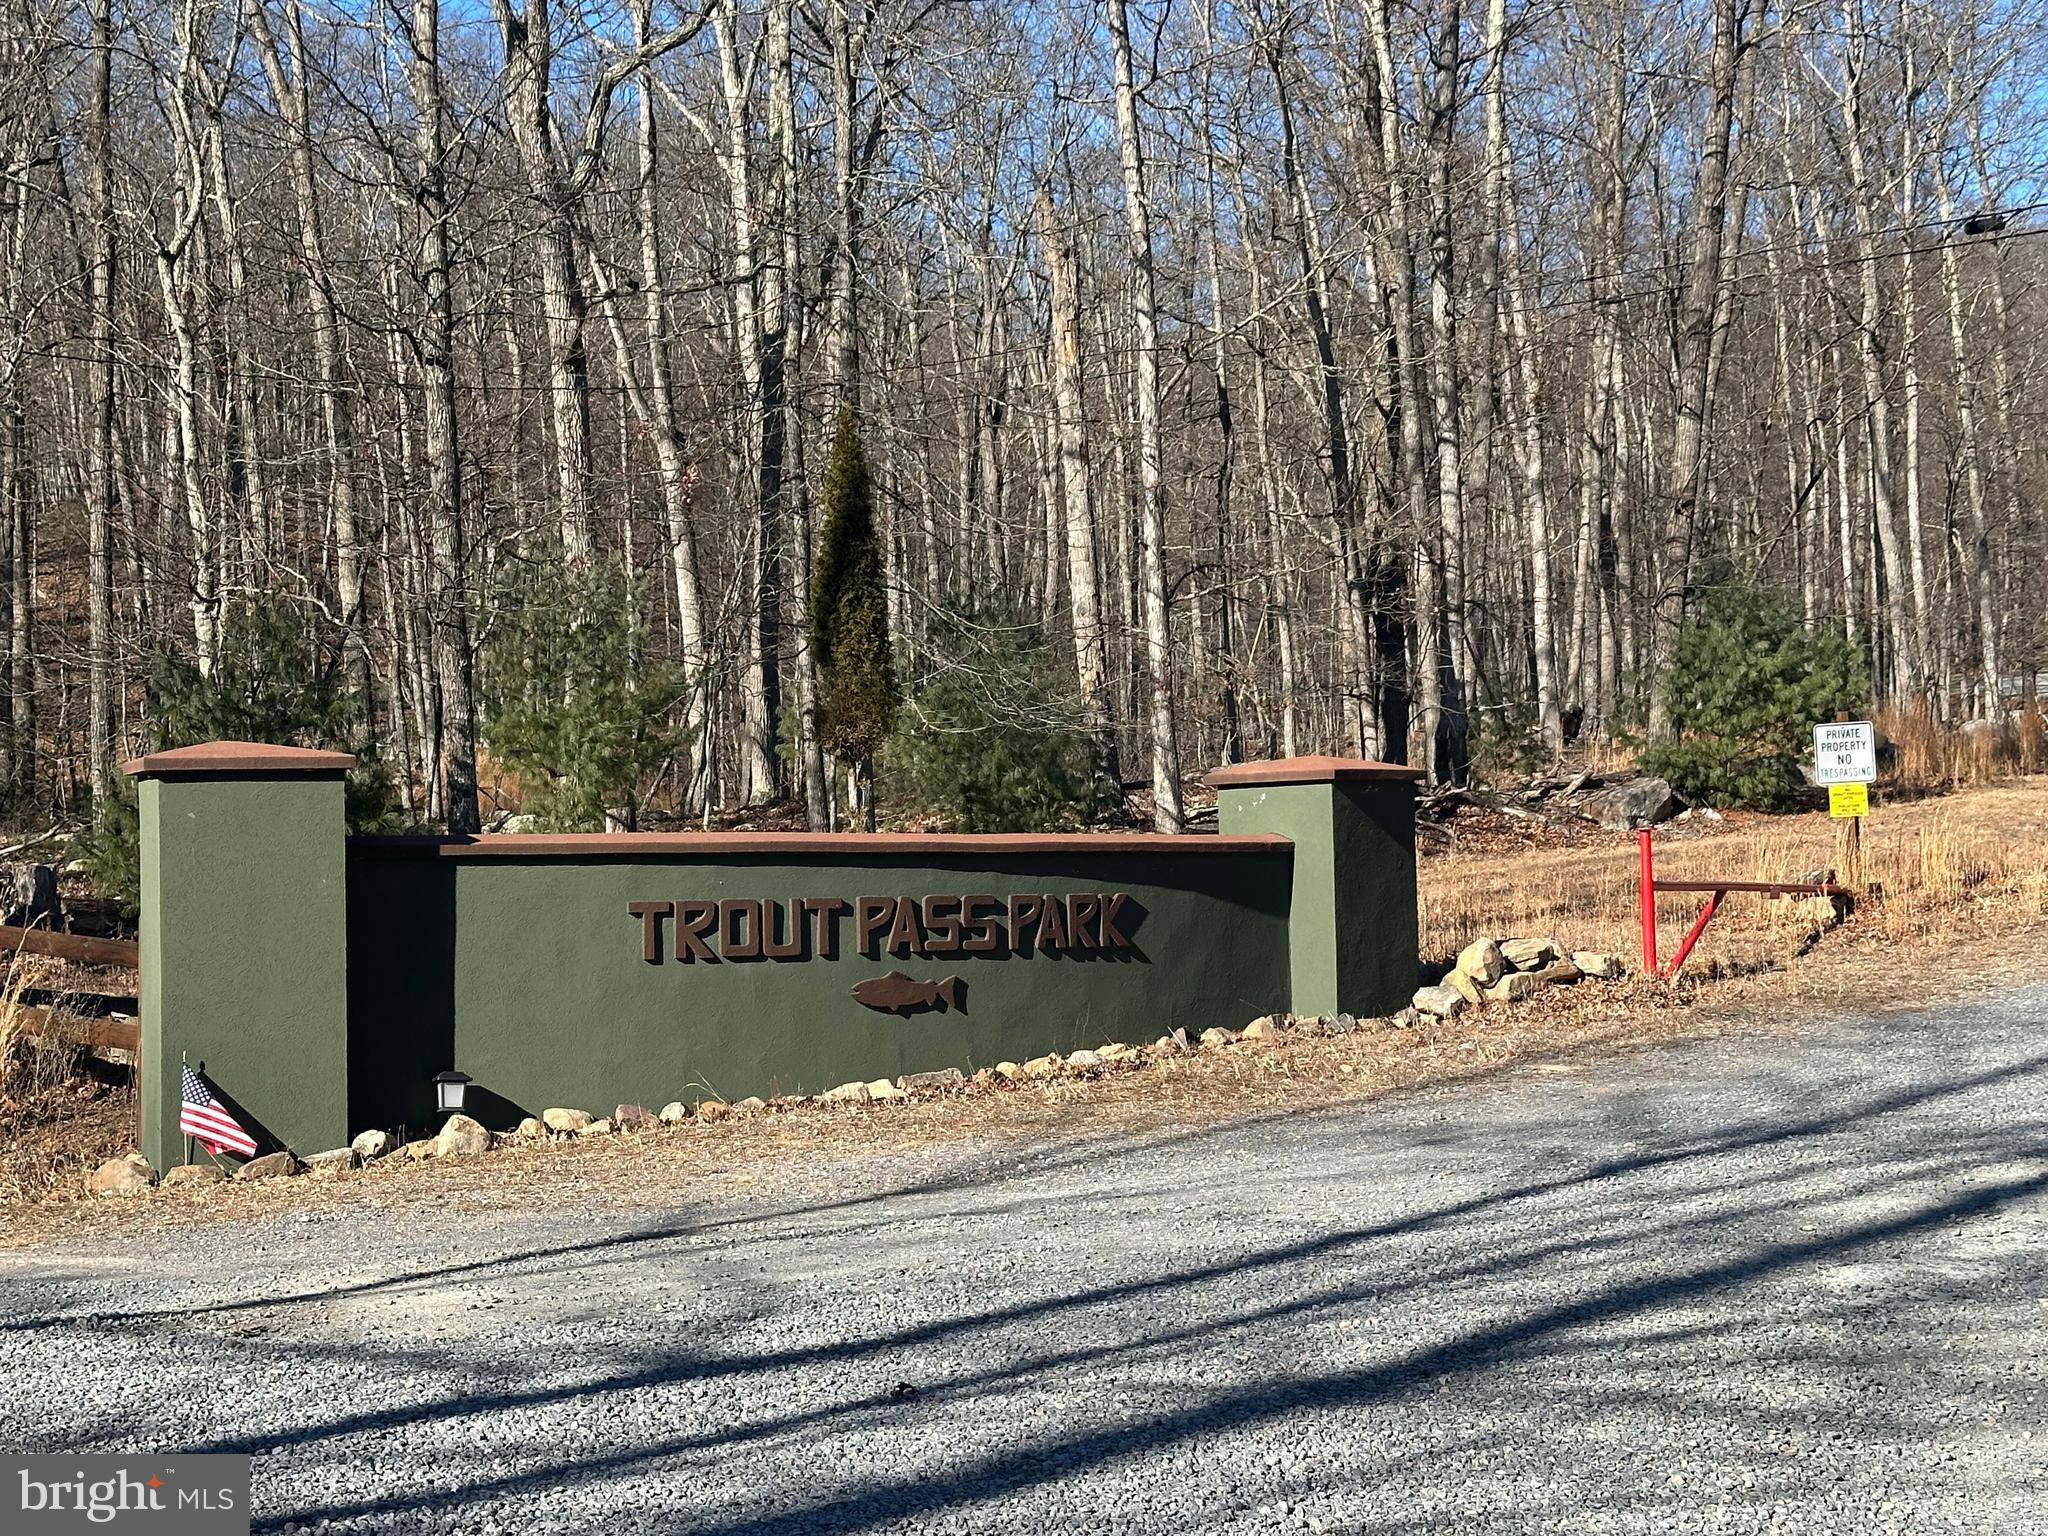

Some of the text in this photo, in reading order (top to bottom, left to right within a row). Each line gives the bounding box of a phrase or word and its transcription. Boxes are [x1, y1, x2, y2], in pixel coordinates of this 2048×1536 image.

[1826, 728, 1861, 739] PRIVATE
[1821, 740, 1866, 752] PROPERTY
[1837, 753, 1852, 765] NO
[1820, 766, 1871, 778] TRESPASSING
[627, 893, 1132, 960] TROUT PASS PARK
